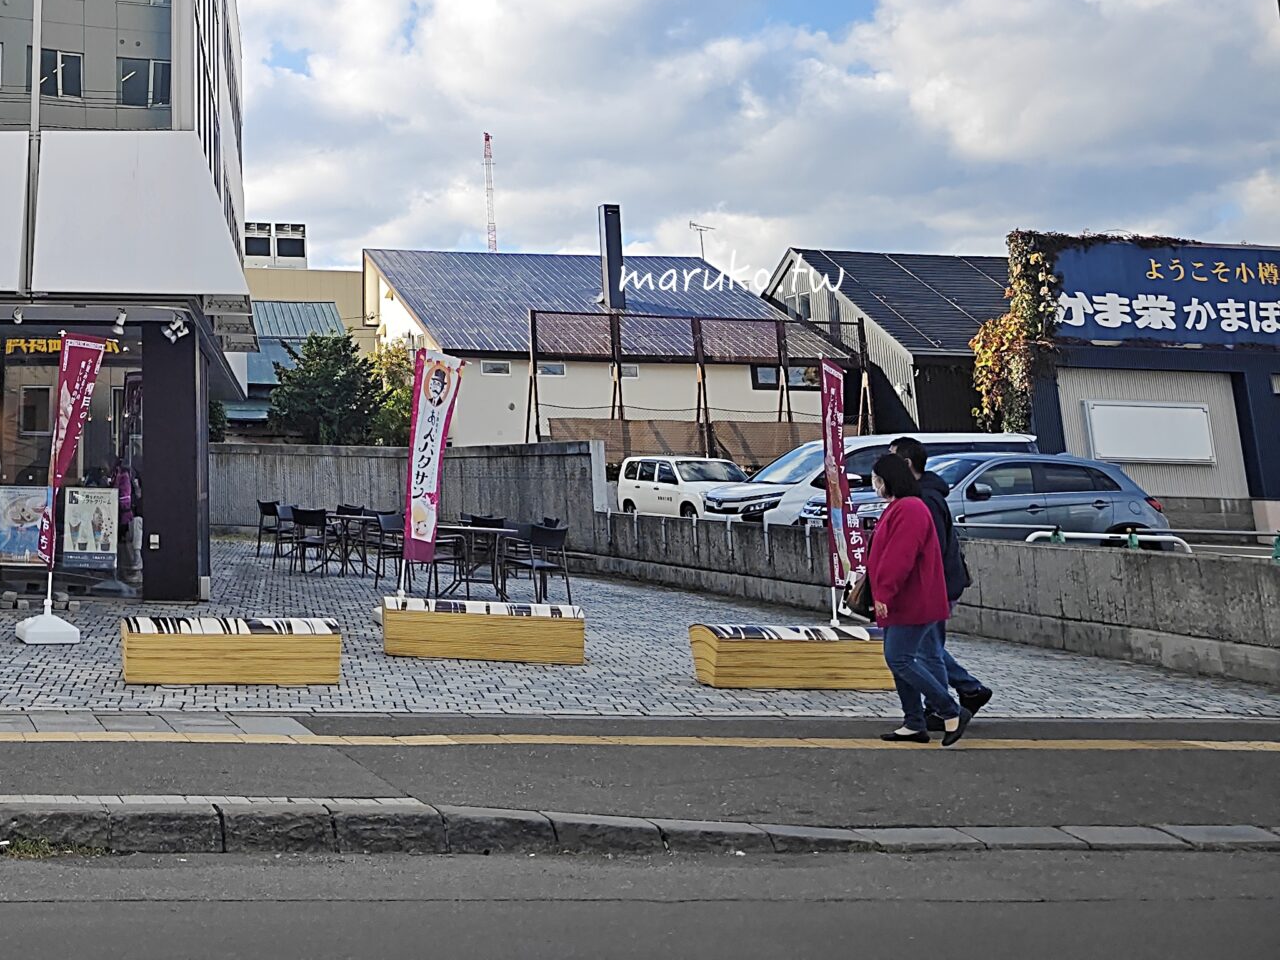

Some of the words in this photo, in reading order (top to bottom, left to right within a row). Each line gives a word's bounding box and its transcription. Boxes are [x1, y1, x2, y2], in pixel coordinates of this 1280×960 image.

[1145, 258, 1280, 286] ようこそ小樽
